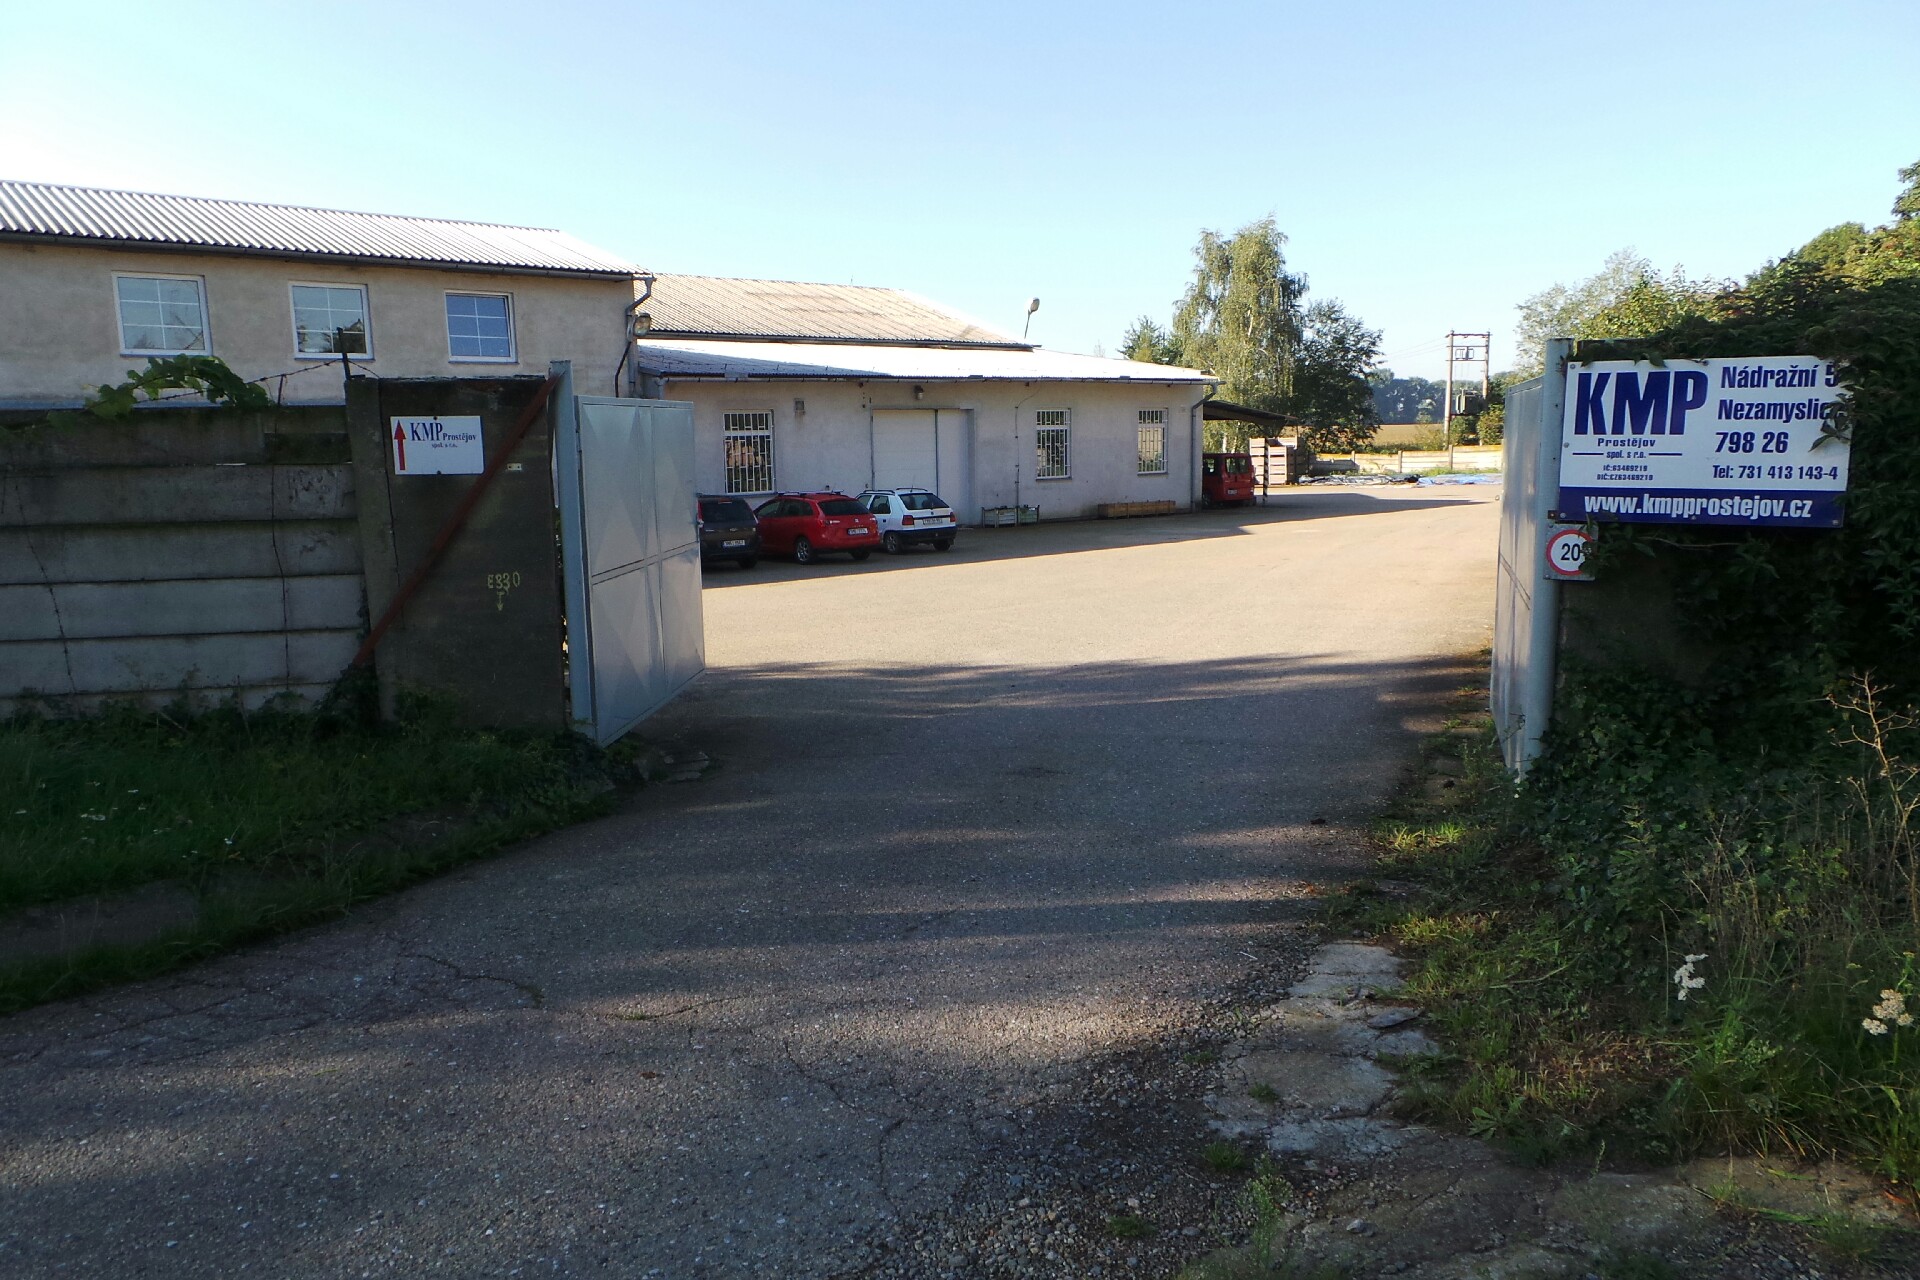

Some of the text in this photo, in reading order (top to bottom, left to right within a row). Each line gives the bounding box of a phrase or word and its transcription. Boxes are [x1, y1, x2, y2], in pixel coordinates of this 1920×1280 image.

[1720, 364, 1820, 389] Nádražní
[1574, 370, 1709, 435] KMP
[1717, 398, 1846, 423] Nezamyslic
[410, 422, 477, 443] KMP Prostějov
[1597, 437, 1656, 448] Prostějov
[1715, 431, 1789, 453] 798 26
[1606, 450, 1624, 459] spol.
[1633, 451, 1647, 459] r.o.
[1712, 464, 1839, 480] Tel: 731 413 143-4
[1584, 493, 1813, 520] www.kmpprostejov.cz
[1560, 543, 1581, 562] 20
